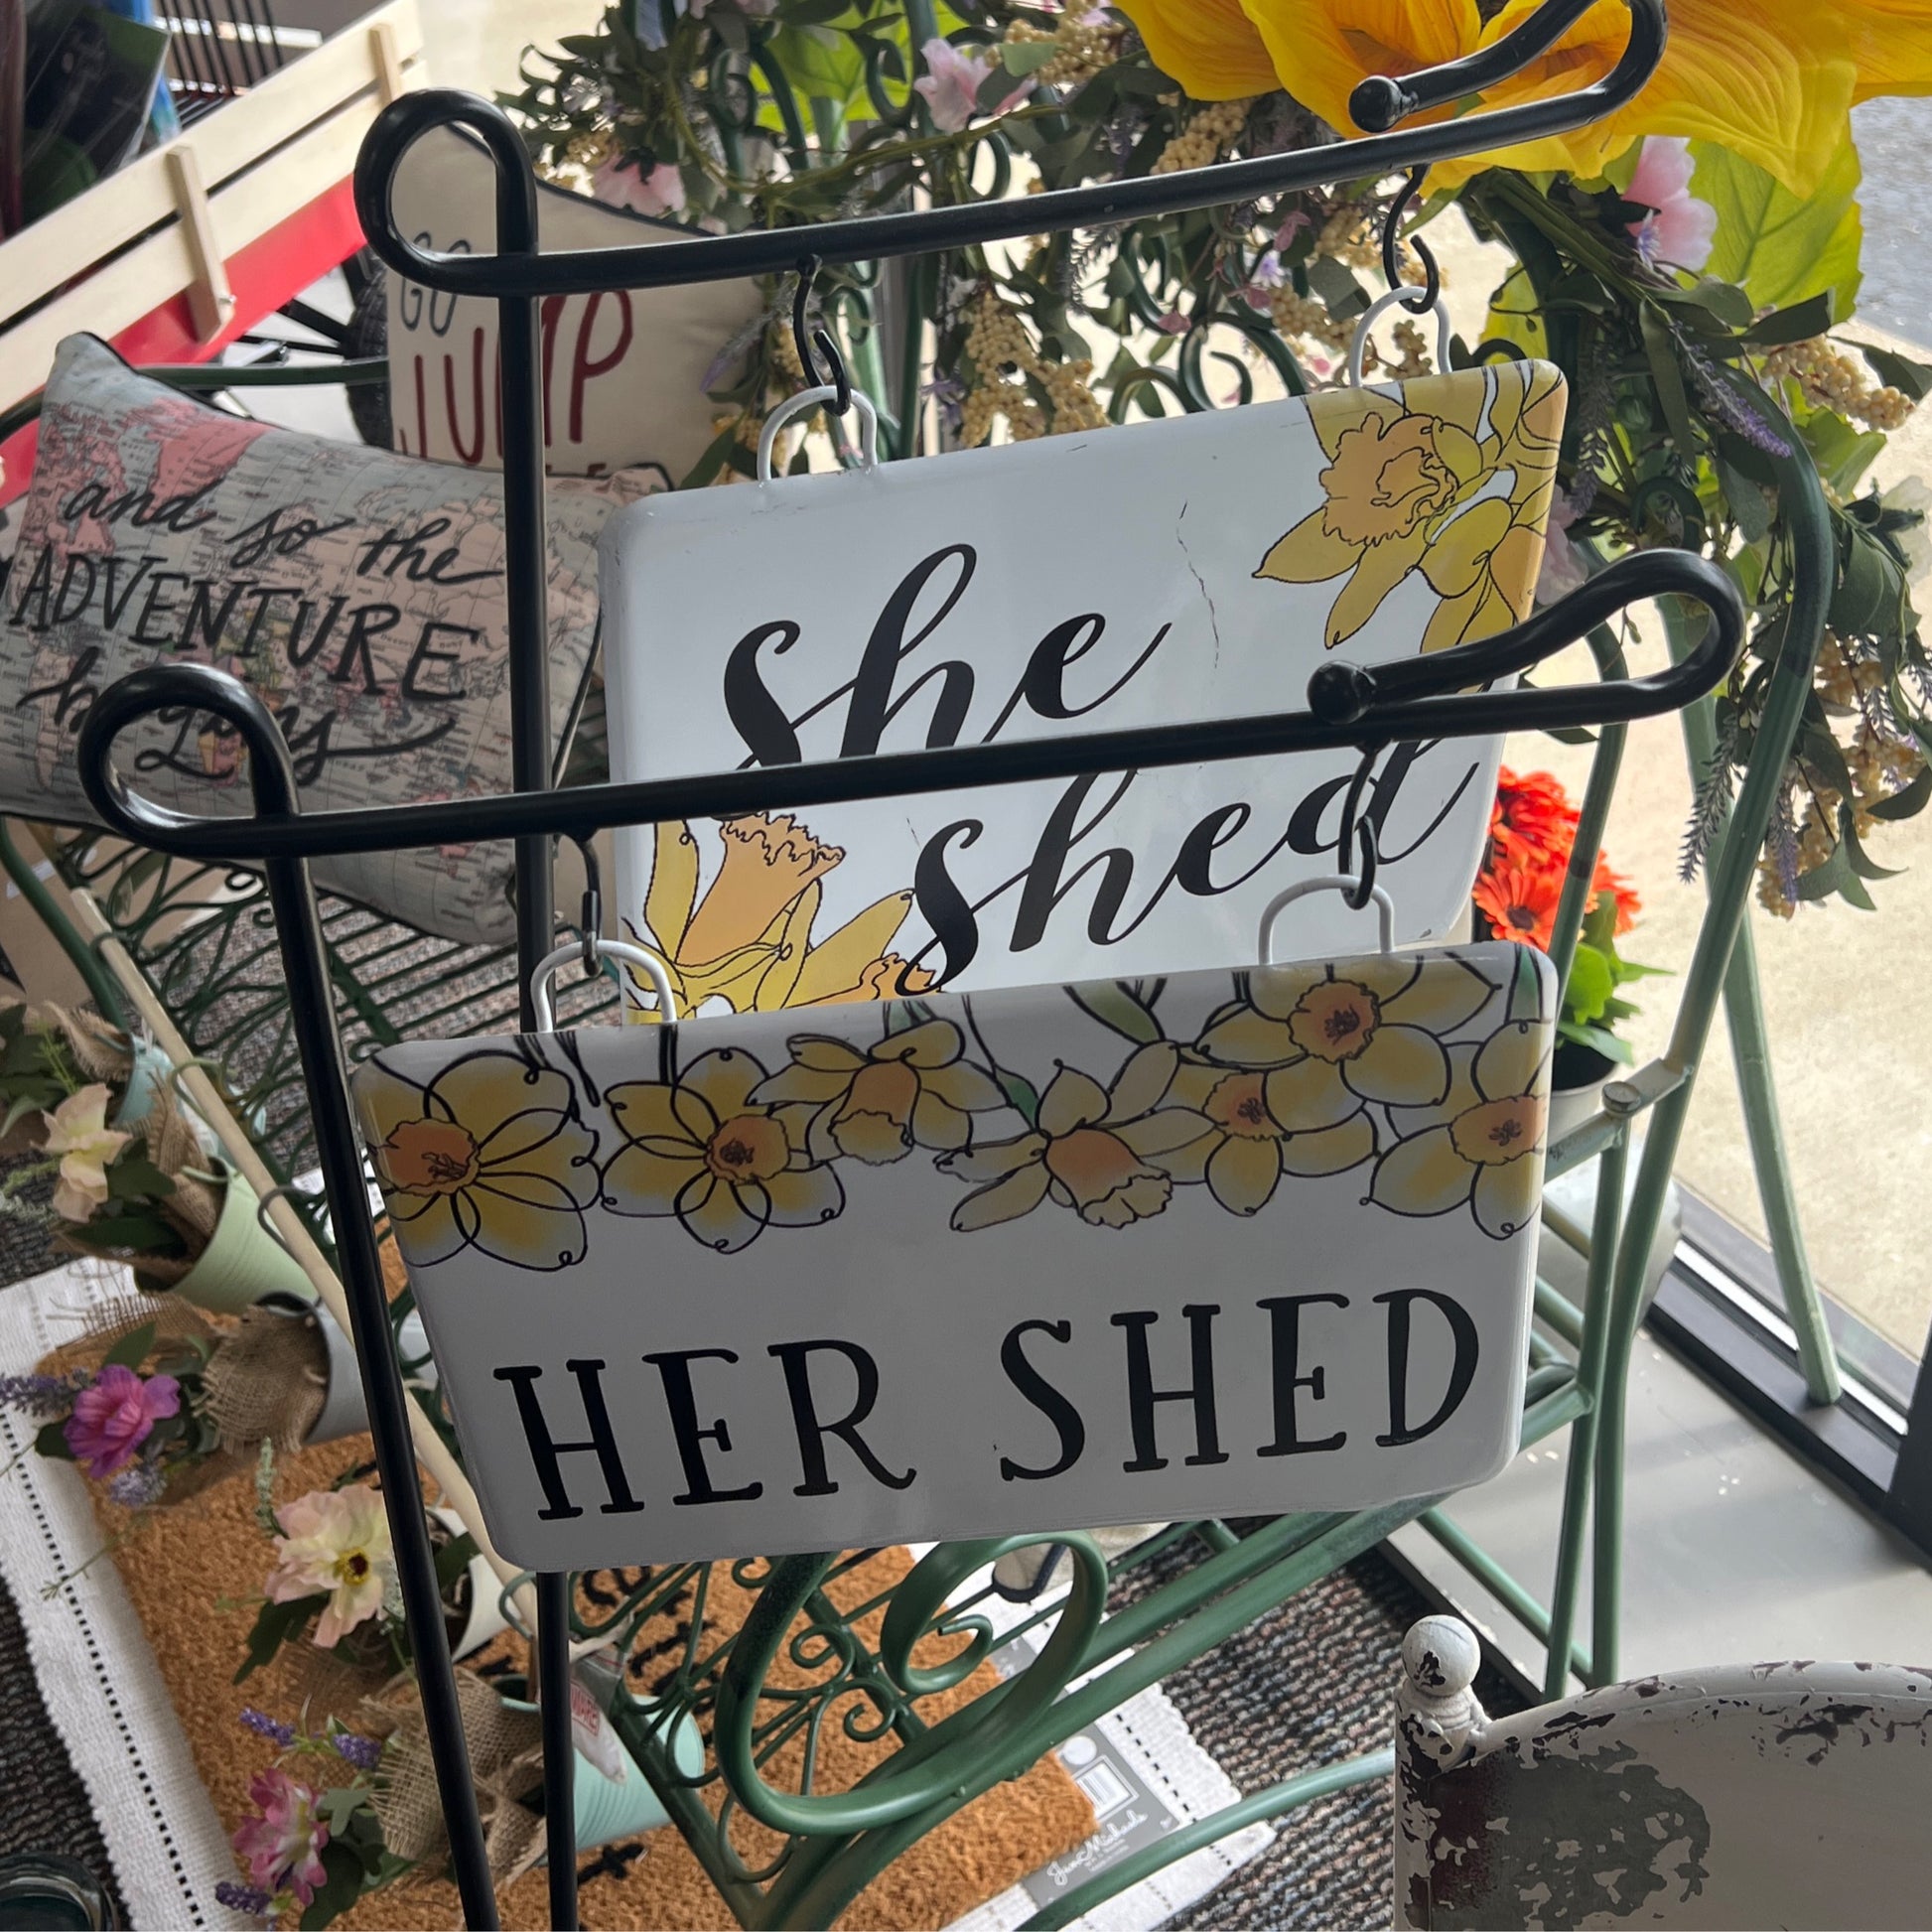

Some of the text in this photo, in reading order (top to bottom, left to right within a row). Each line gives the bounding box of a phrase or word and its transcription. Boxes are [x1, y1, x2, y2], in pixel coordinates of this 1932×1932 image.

[9, 548, 480, 700] ADVENTURE
[65, 481, 505, 586] and so the
[15, 645, 457, 787] bgs
[711, 543, 1173, 821] she
[896, 737, 1479, 994] shed
[493, 1289, 1479, 1520] HER SHED
